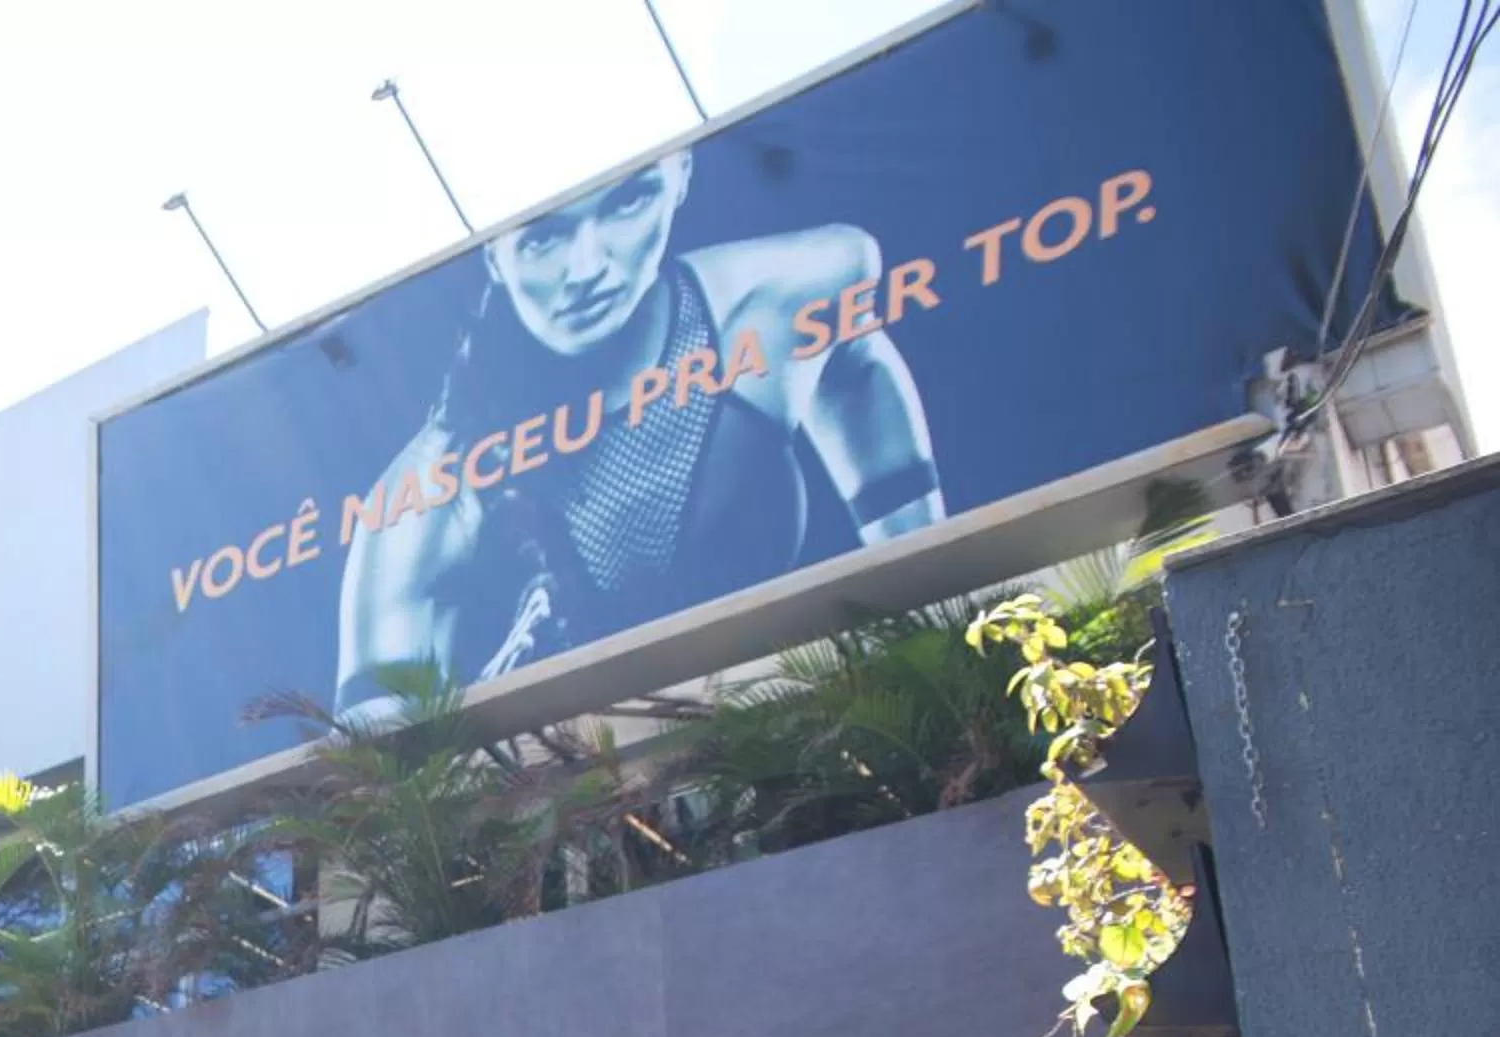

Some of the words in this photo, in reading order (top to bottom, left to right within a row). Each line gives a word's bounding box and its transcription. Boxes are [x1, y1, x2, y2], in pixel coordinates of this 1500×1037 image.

[170, 502, 322, 614] VOCÊ
[340, 395, 604, 547] NASCEU
[627, 327, 770, 428] PRA
[791, 256, 942, 361] SER
[962, 168, 1159, 284] TOP.
